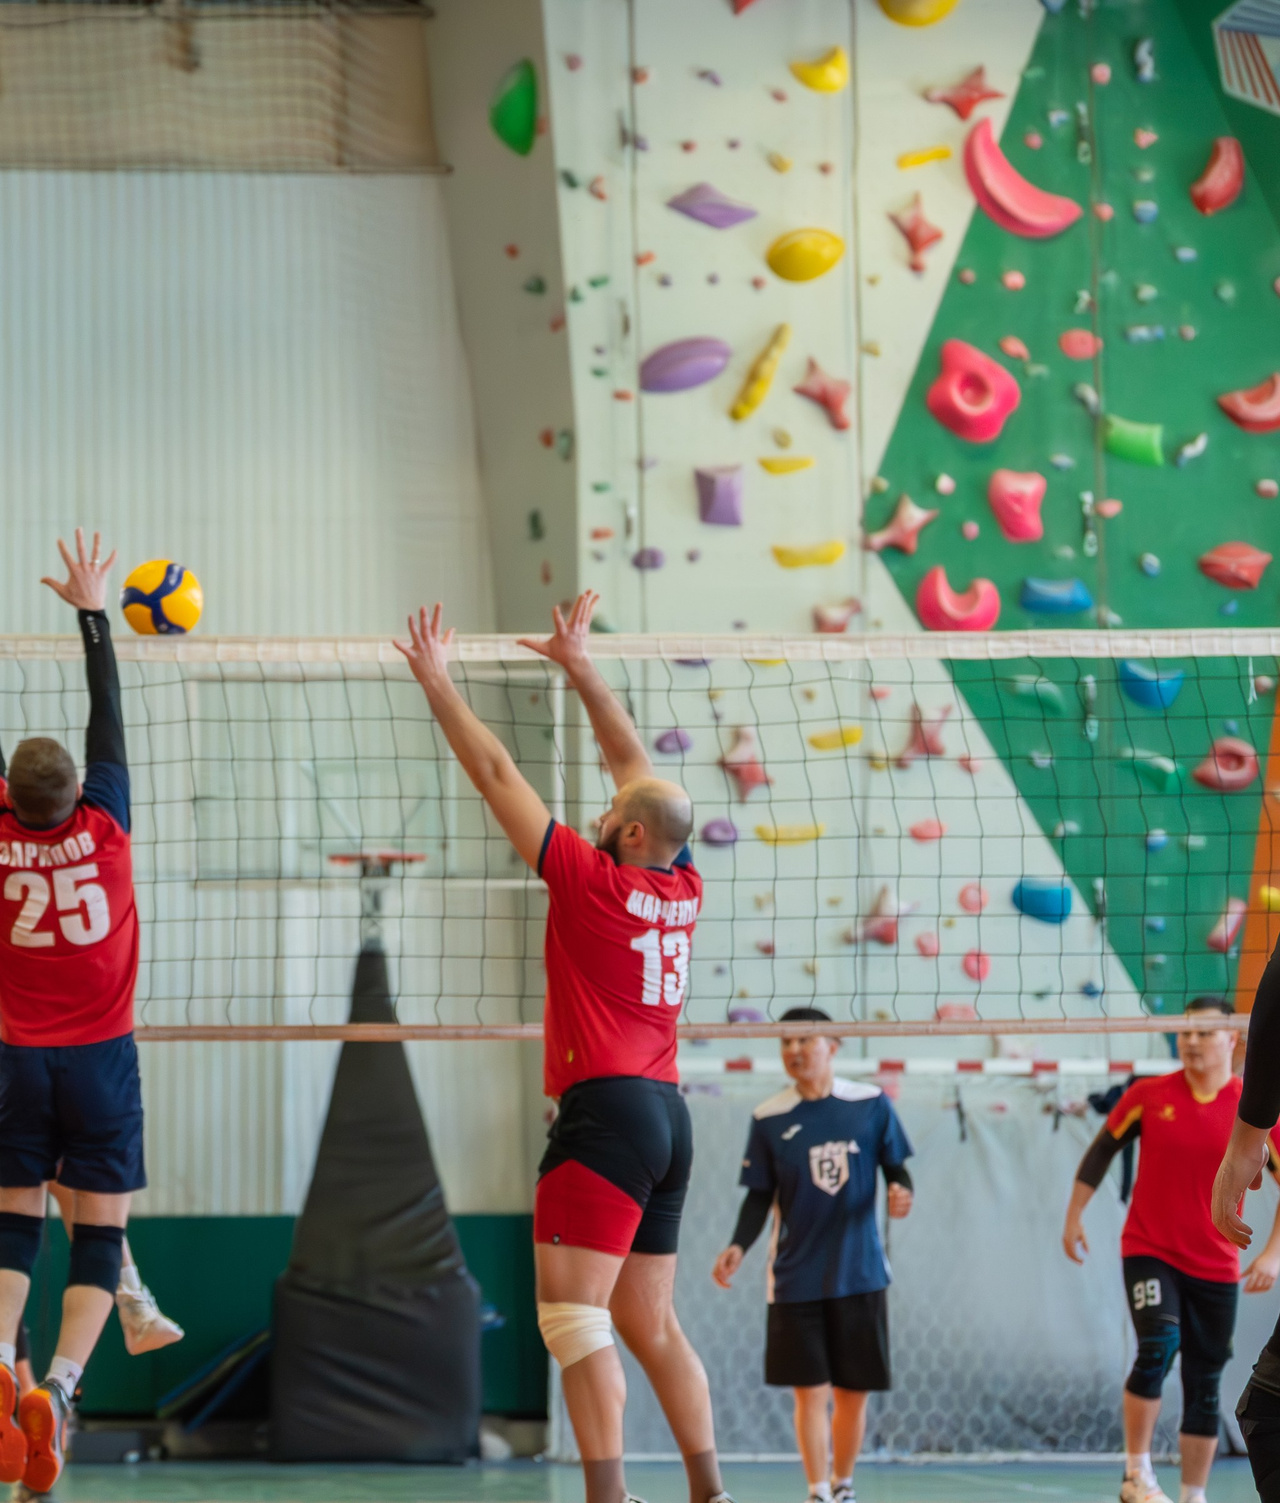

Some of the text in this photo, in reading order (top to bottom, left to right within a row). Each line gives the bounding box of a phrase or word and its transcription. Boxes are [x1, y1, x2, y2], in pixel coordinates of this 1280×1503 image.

[3, 862, 111, 948] 25
[630, 928, 690, 1006] 13
[1133, 1277, 1161, 1310] 99
